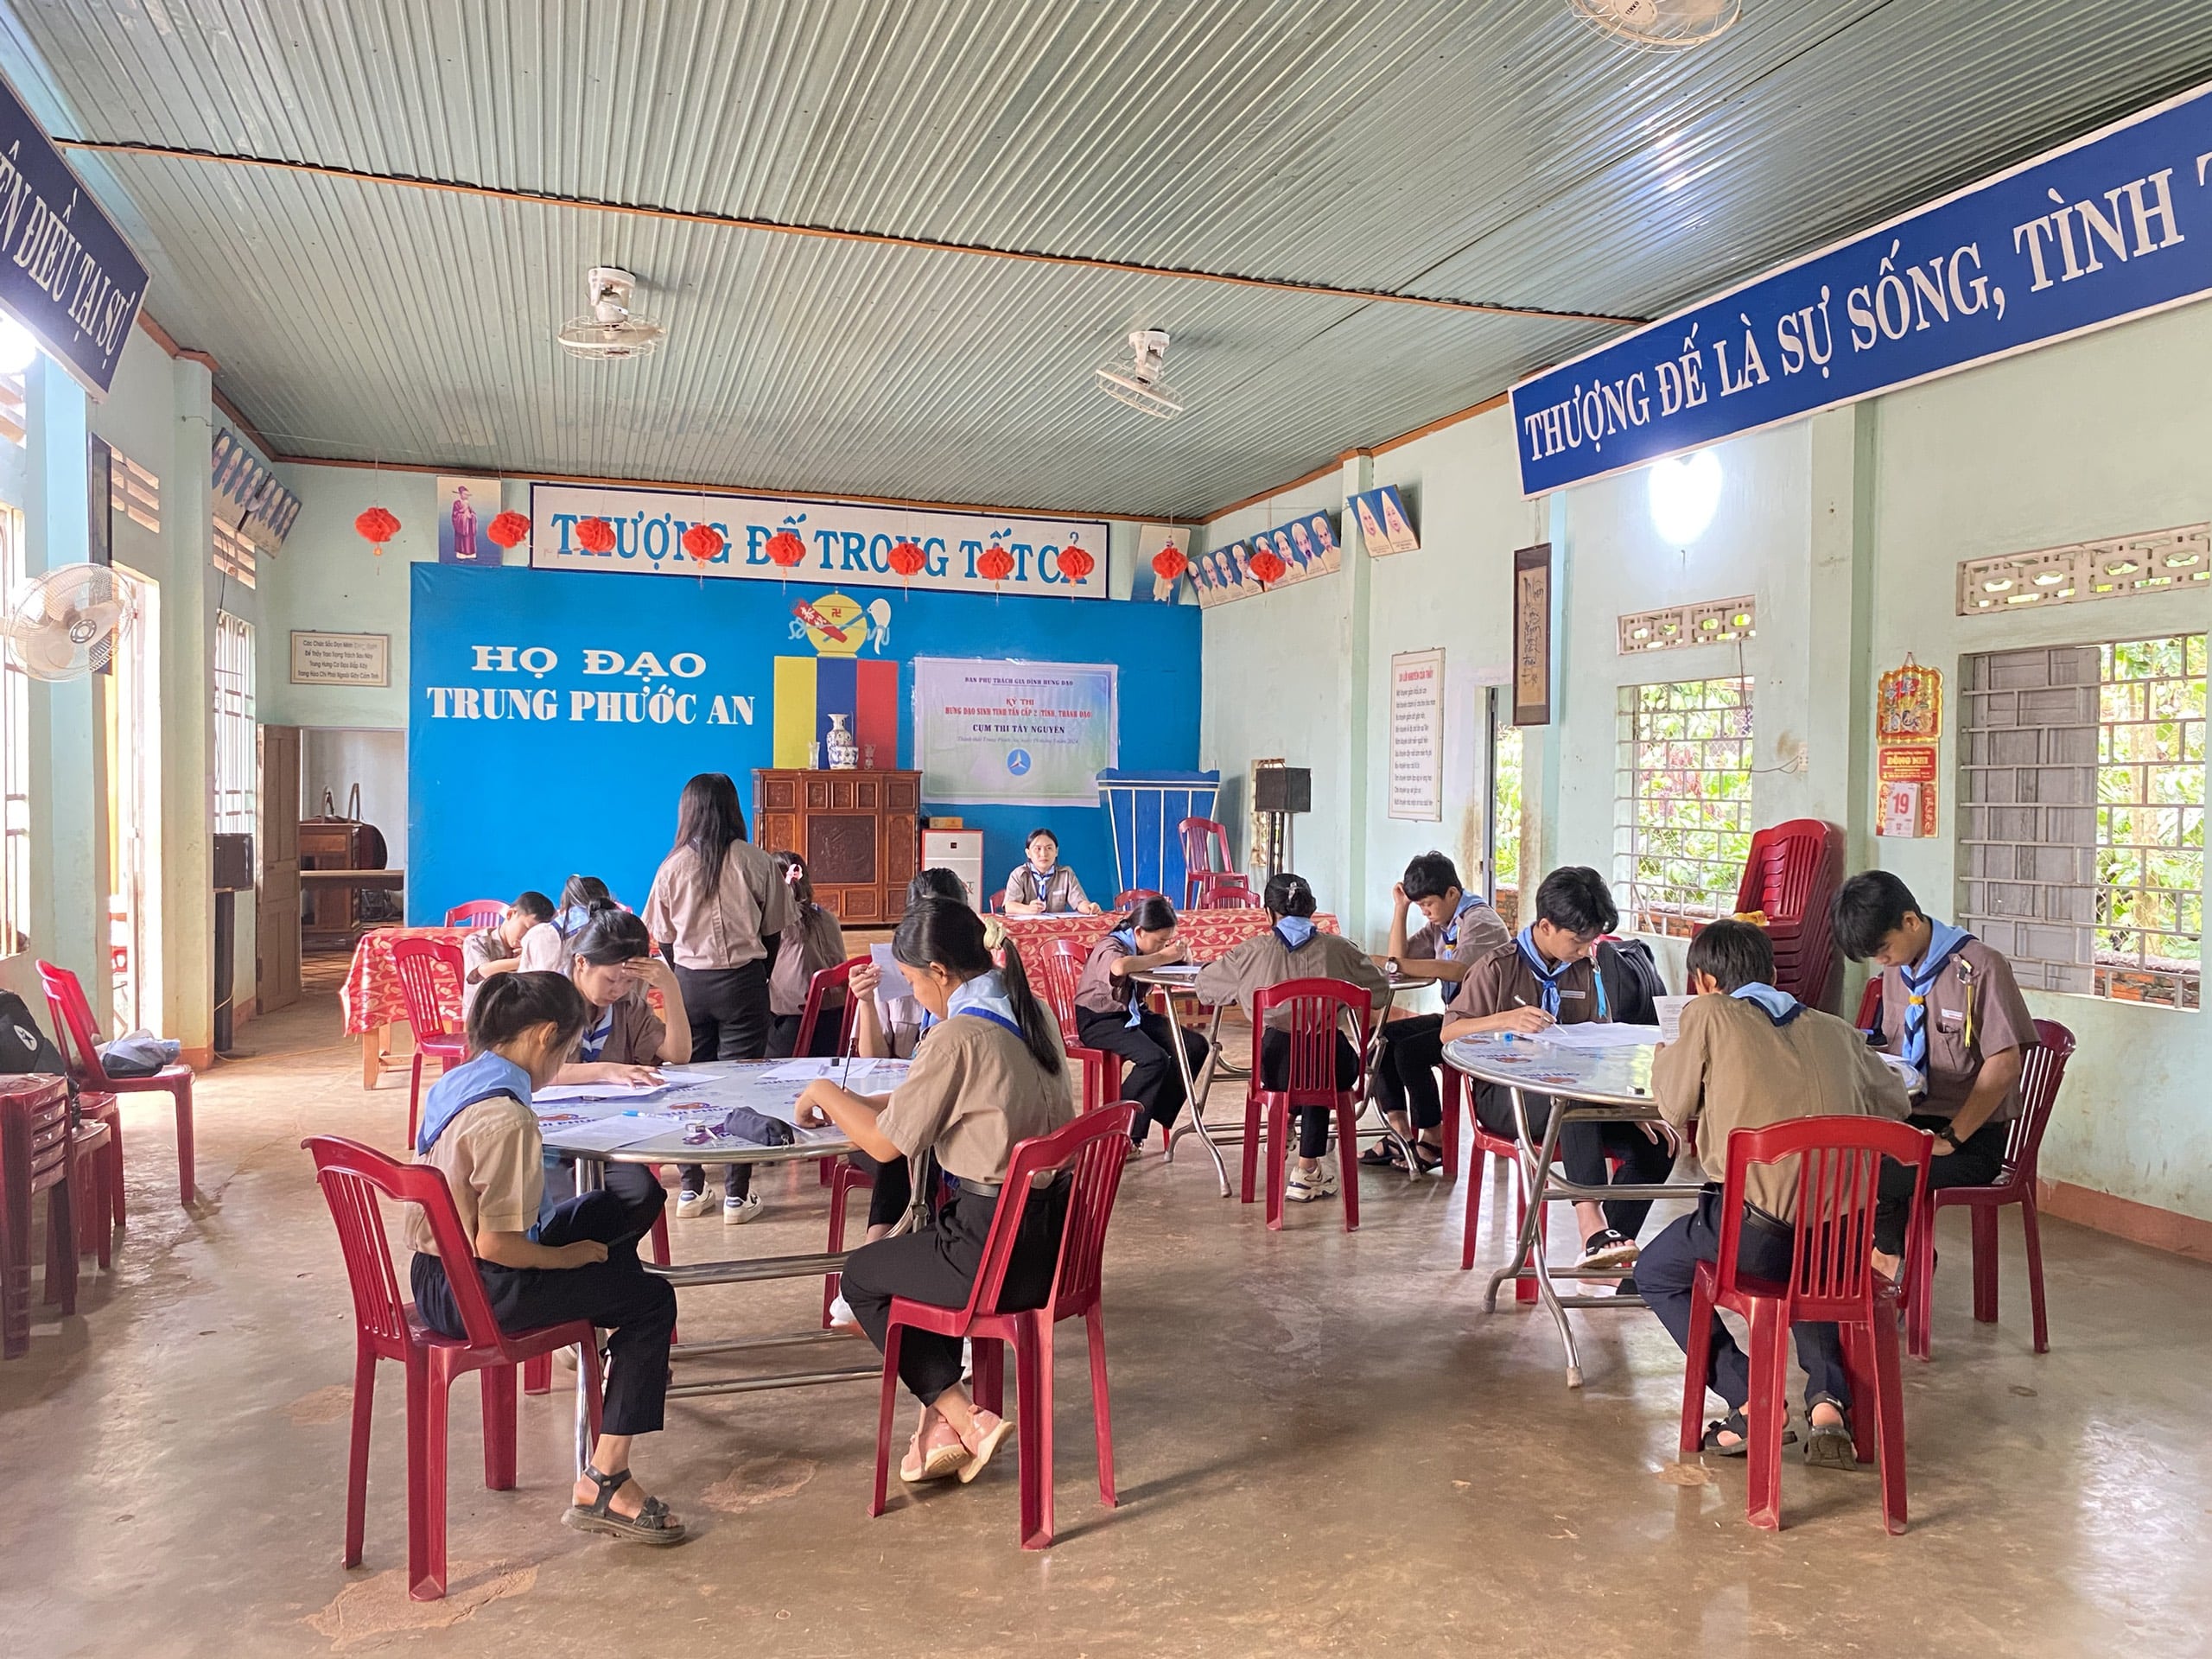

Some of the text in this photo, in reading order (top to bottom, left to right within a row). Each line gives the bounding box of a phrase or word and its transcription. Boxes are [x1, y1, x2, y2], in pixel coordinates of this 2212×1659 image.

[67, 252, 111, 342] TẠI
[95, 291, 137, 370] SỰ
[1524, 168, 2185, 461] THƯỢNG ĐẾ LÀ SỰ SỐNG, TÌNH
[814, 530, 949, 576] TROG
[471, 645, 706, 683] HỌ ĐẠO
[427, 684, 755, 725] TRUNG PHƯỚC AN
[973, 724, 1065, 734] CỤM THI TÂY NGUYÊN
[1893, 793, 1909, 815] 19
